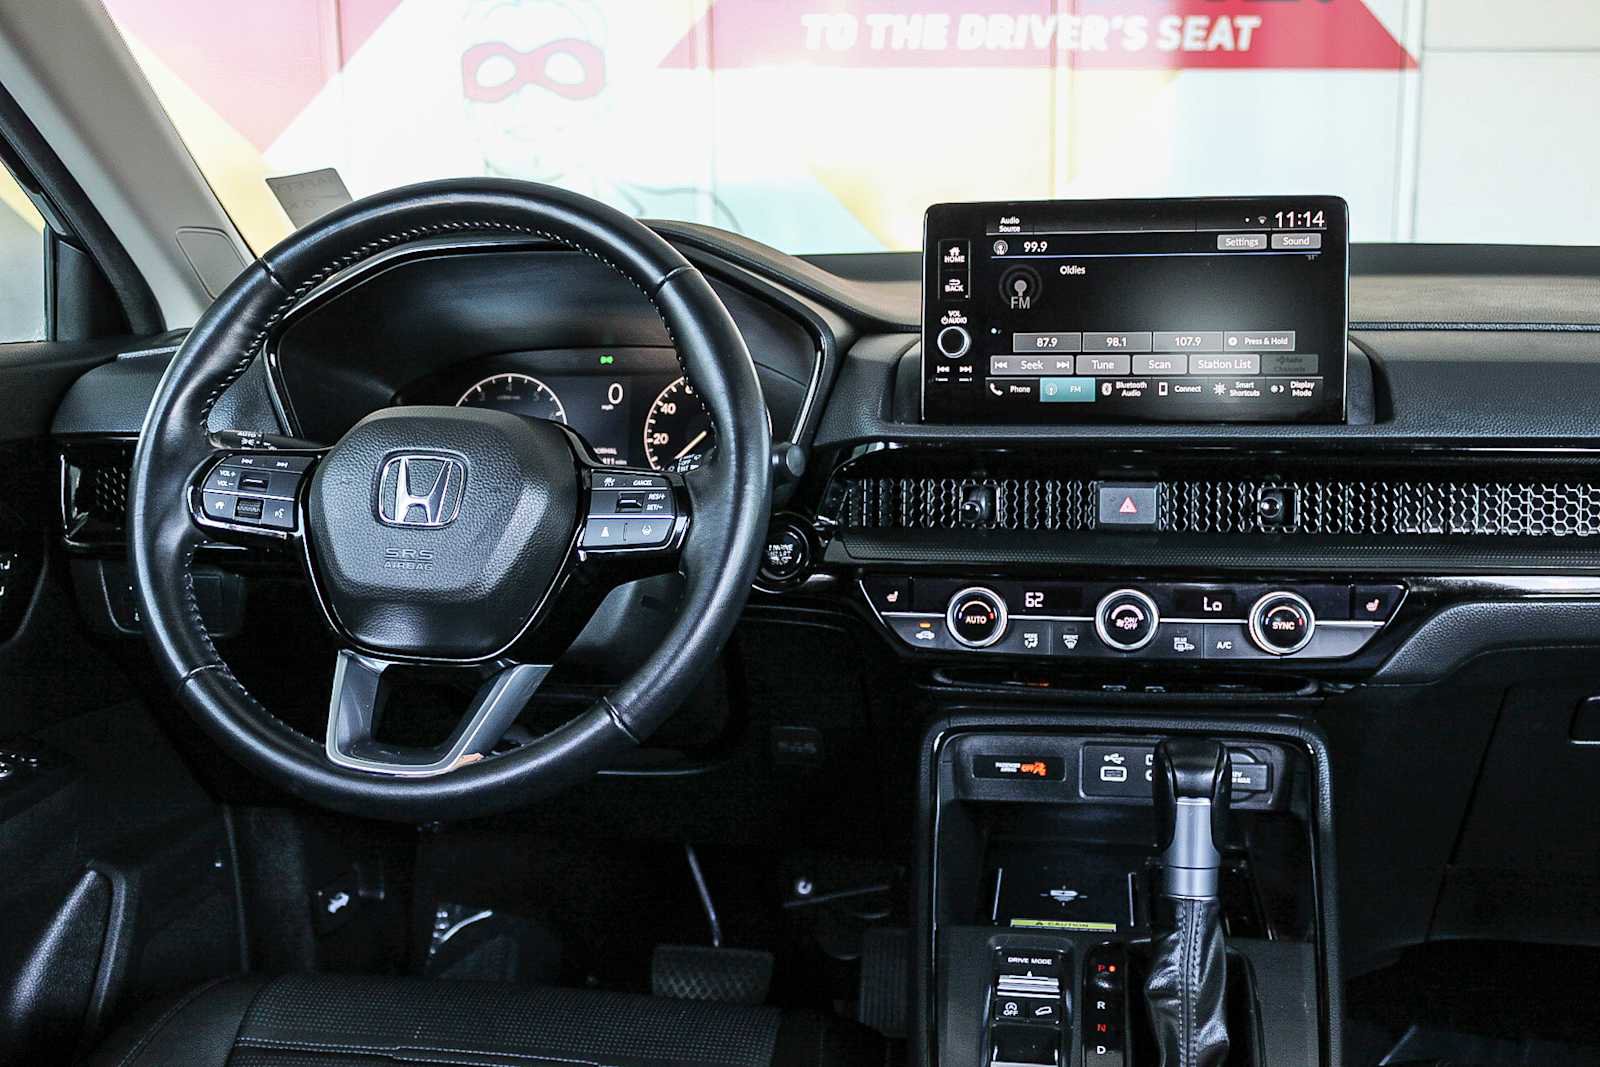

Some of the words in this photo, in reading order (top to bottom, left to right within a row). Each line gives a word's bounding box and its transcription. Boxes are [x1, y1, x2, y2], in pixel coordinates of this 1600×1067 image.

[801, 14, 859, 50] TO
[865, 14, 950, 50] THE
[957, 14, 1148, 51] DRIVER'S
[1156, 15, 1262, 51] SEAT
[1000, 216, 1020, 225] Audio
[1274, 211, 1325, 228] 11:14
[999, 225, 1021, 233] Source
[1225, 237, 1259, 247] Settings
[1282, 236, 1310, 246] Sound
[1023, 241, 1048, 253] 99.9
[944, 255, 965, 263] HOME
[1059, 265, 1086, 275] Oldies
[945, 284, 964, 292] BACK
[1010, 296, 1031, 310] FM
[1036, 337, 1058, 348] 87.9
[1106, 336, 1127, 347] 98.1
[1175, 336, 1202, 347] 107.9
[1244, 336, 1262, 346] Press
[1271, 336, 1289, 346] Hold
[1020, 359, 1044, 371] Seek
[1091, 359, 1115, 370] Tune
[1148, 359, 1172, 370] Scan
[1198, 359, 1232, 370] Station
[1234, 359, 1252, 370] List
[1010, 384, 1031, 394] Phone
[1070, 385, 1082, 393] FM
[1115, 381, 1148, 390] Bluetooth
[1174, 384, 1202, 394] Connect
[1235, 381, 1255, 390] Smart
[1290, 381, 1316, 391] Display
[608, 382, 624, 405] 0
[1121, 389, 1142, 398] Audio
[1292, 389, 1313, 397] Mode
[660, 403, 676, 415] 40
[653, 433, 669, 445] 20
[385, 547, 434, 560] SRS
[383, 561, 433, 571] AIRBAG
[1025, 592, 1044, 607] 62
[965, 615, 987, 625] AUTO
[1272, 621, 1295, 631] SYNC
[1216, 641, 1232, 650] A/C
[1007, 956, 1029, 964] DRIVE
[1031, 957, 1052, 965] MODE
[1096, 1001, 1106, 1010] R
[1003, 1009, 1019, 1017] OFF
[1097, 1023, 1107, 1033] N
[1096, 1045, 1107, 1055] D
